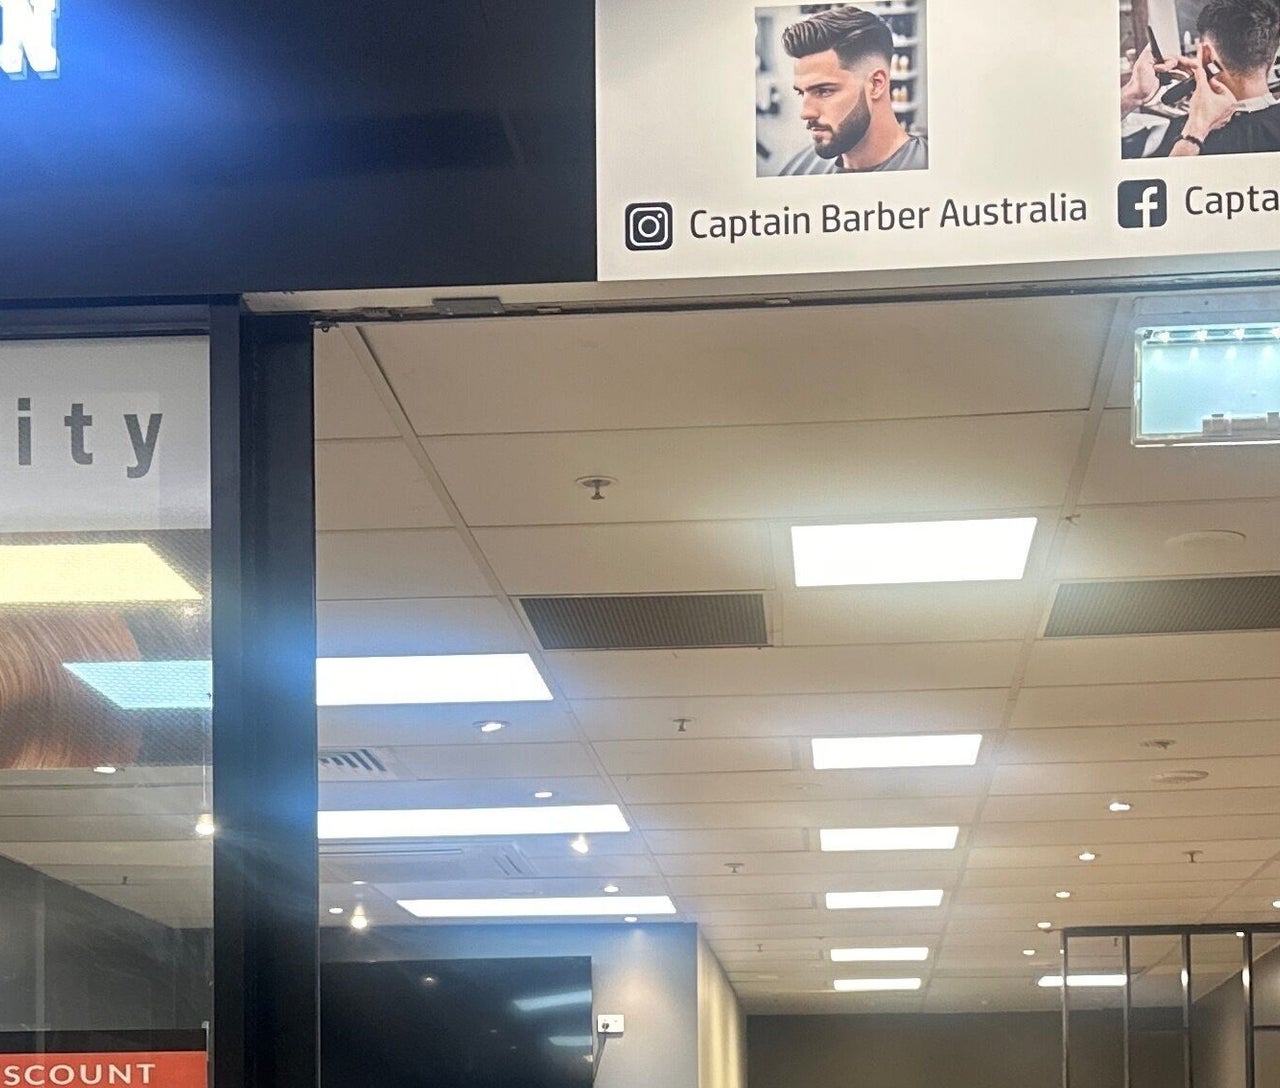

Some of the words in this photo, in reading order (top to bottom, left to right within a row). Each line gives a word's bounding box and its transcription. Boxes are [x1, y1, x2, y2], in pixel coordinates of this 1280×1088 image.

[688, 201, 812, 243] Captain
[821, 196, 931, 235] Barber
[939, 190, 1088, 230] Australia
